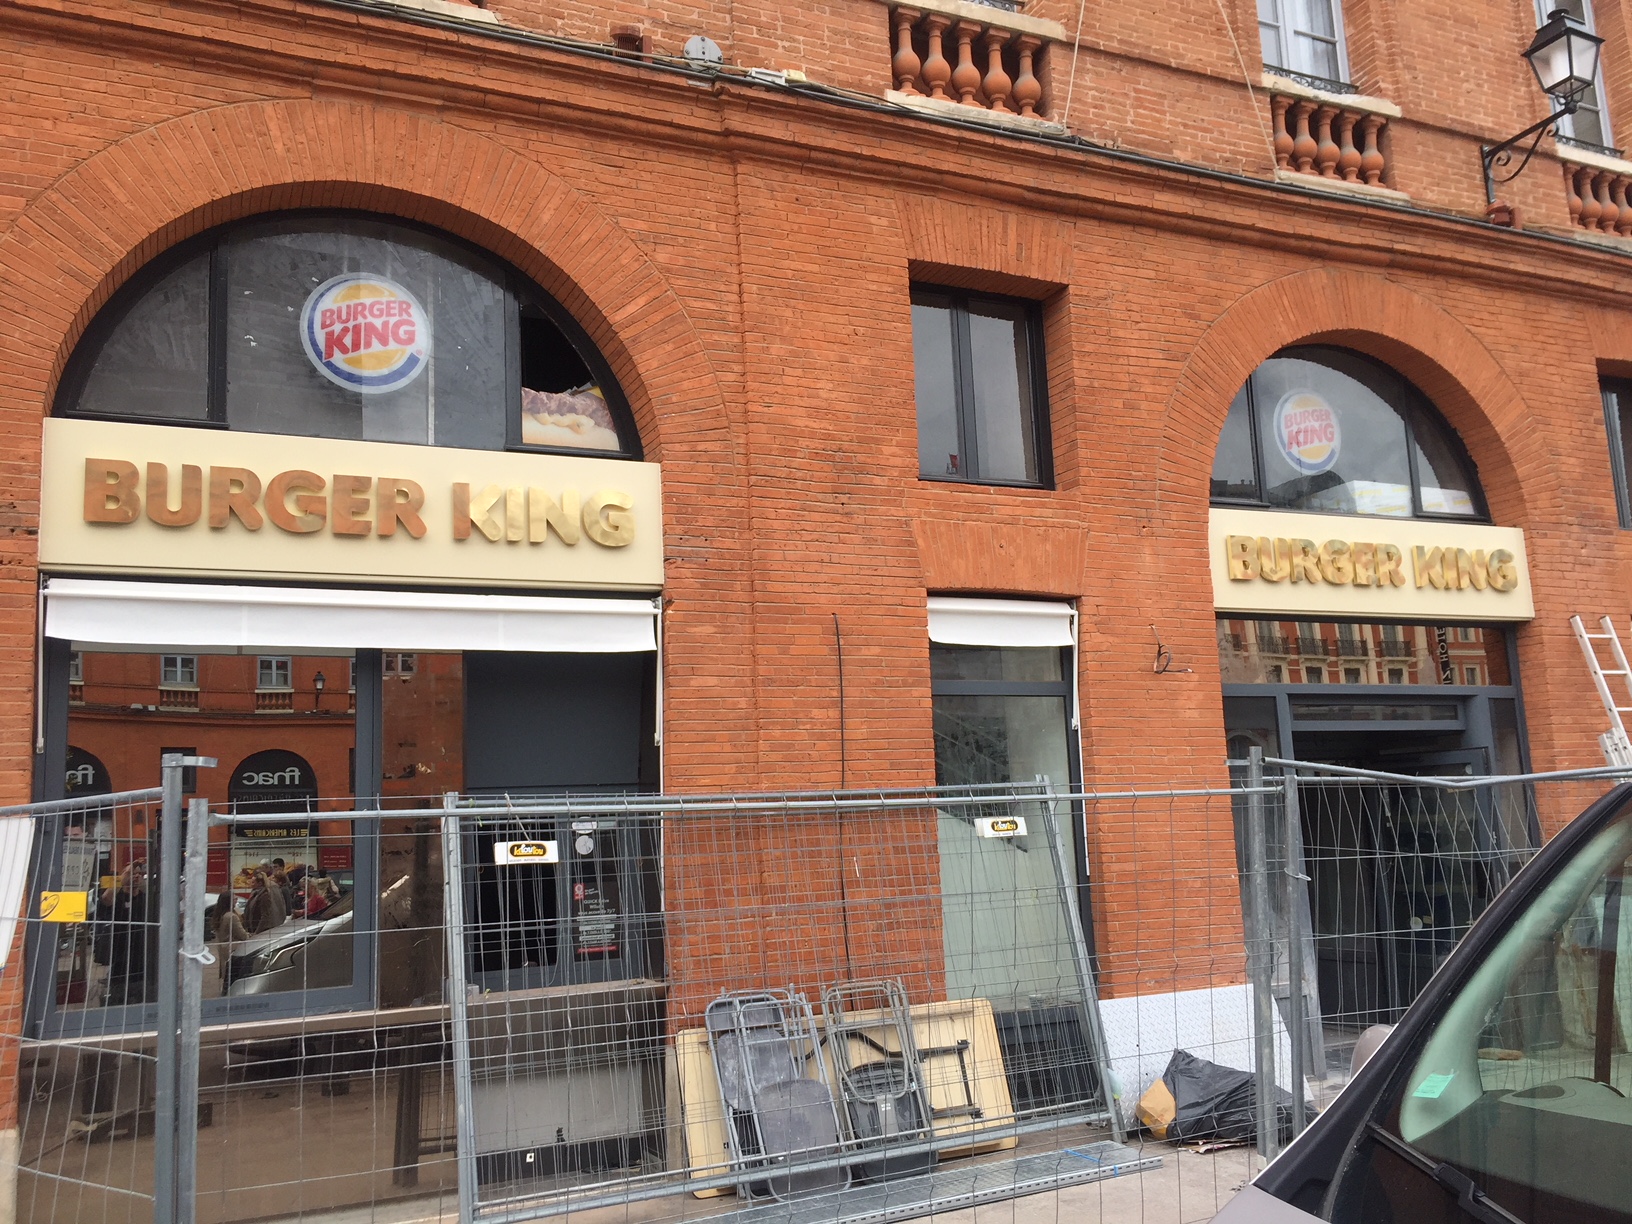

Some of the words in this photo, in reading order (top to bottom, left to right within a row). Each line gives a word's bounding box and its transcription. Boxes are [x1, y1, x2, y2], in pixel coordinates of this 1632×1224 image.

[320, 300, 413, 331] BURGER
[323, 318, 417, 361] KING
[1284, 408, 1332, 430] BURGER
[1286, 422, 1335, 451] KING
[83, 457, 427, 539] BURGER
[452, 482, 636, 547] KING
[1226, 535, 1406, 587] BURGER
[1412, 545, 1519, 592] KING
